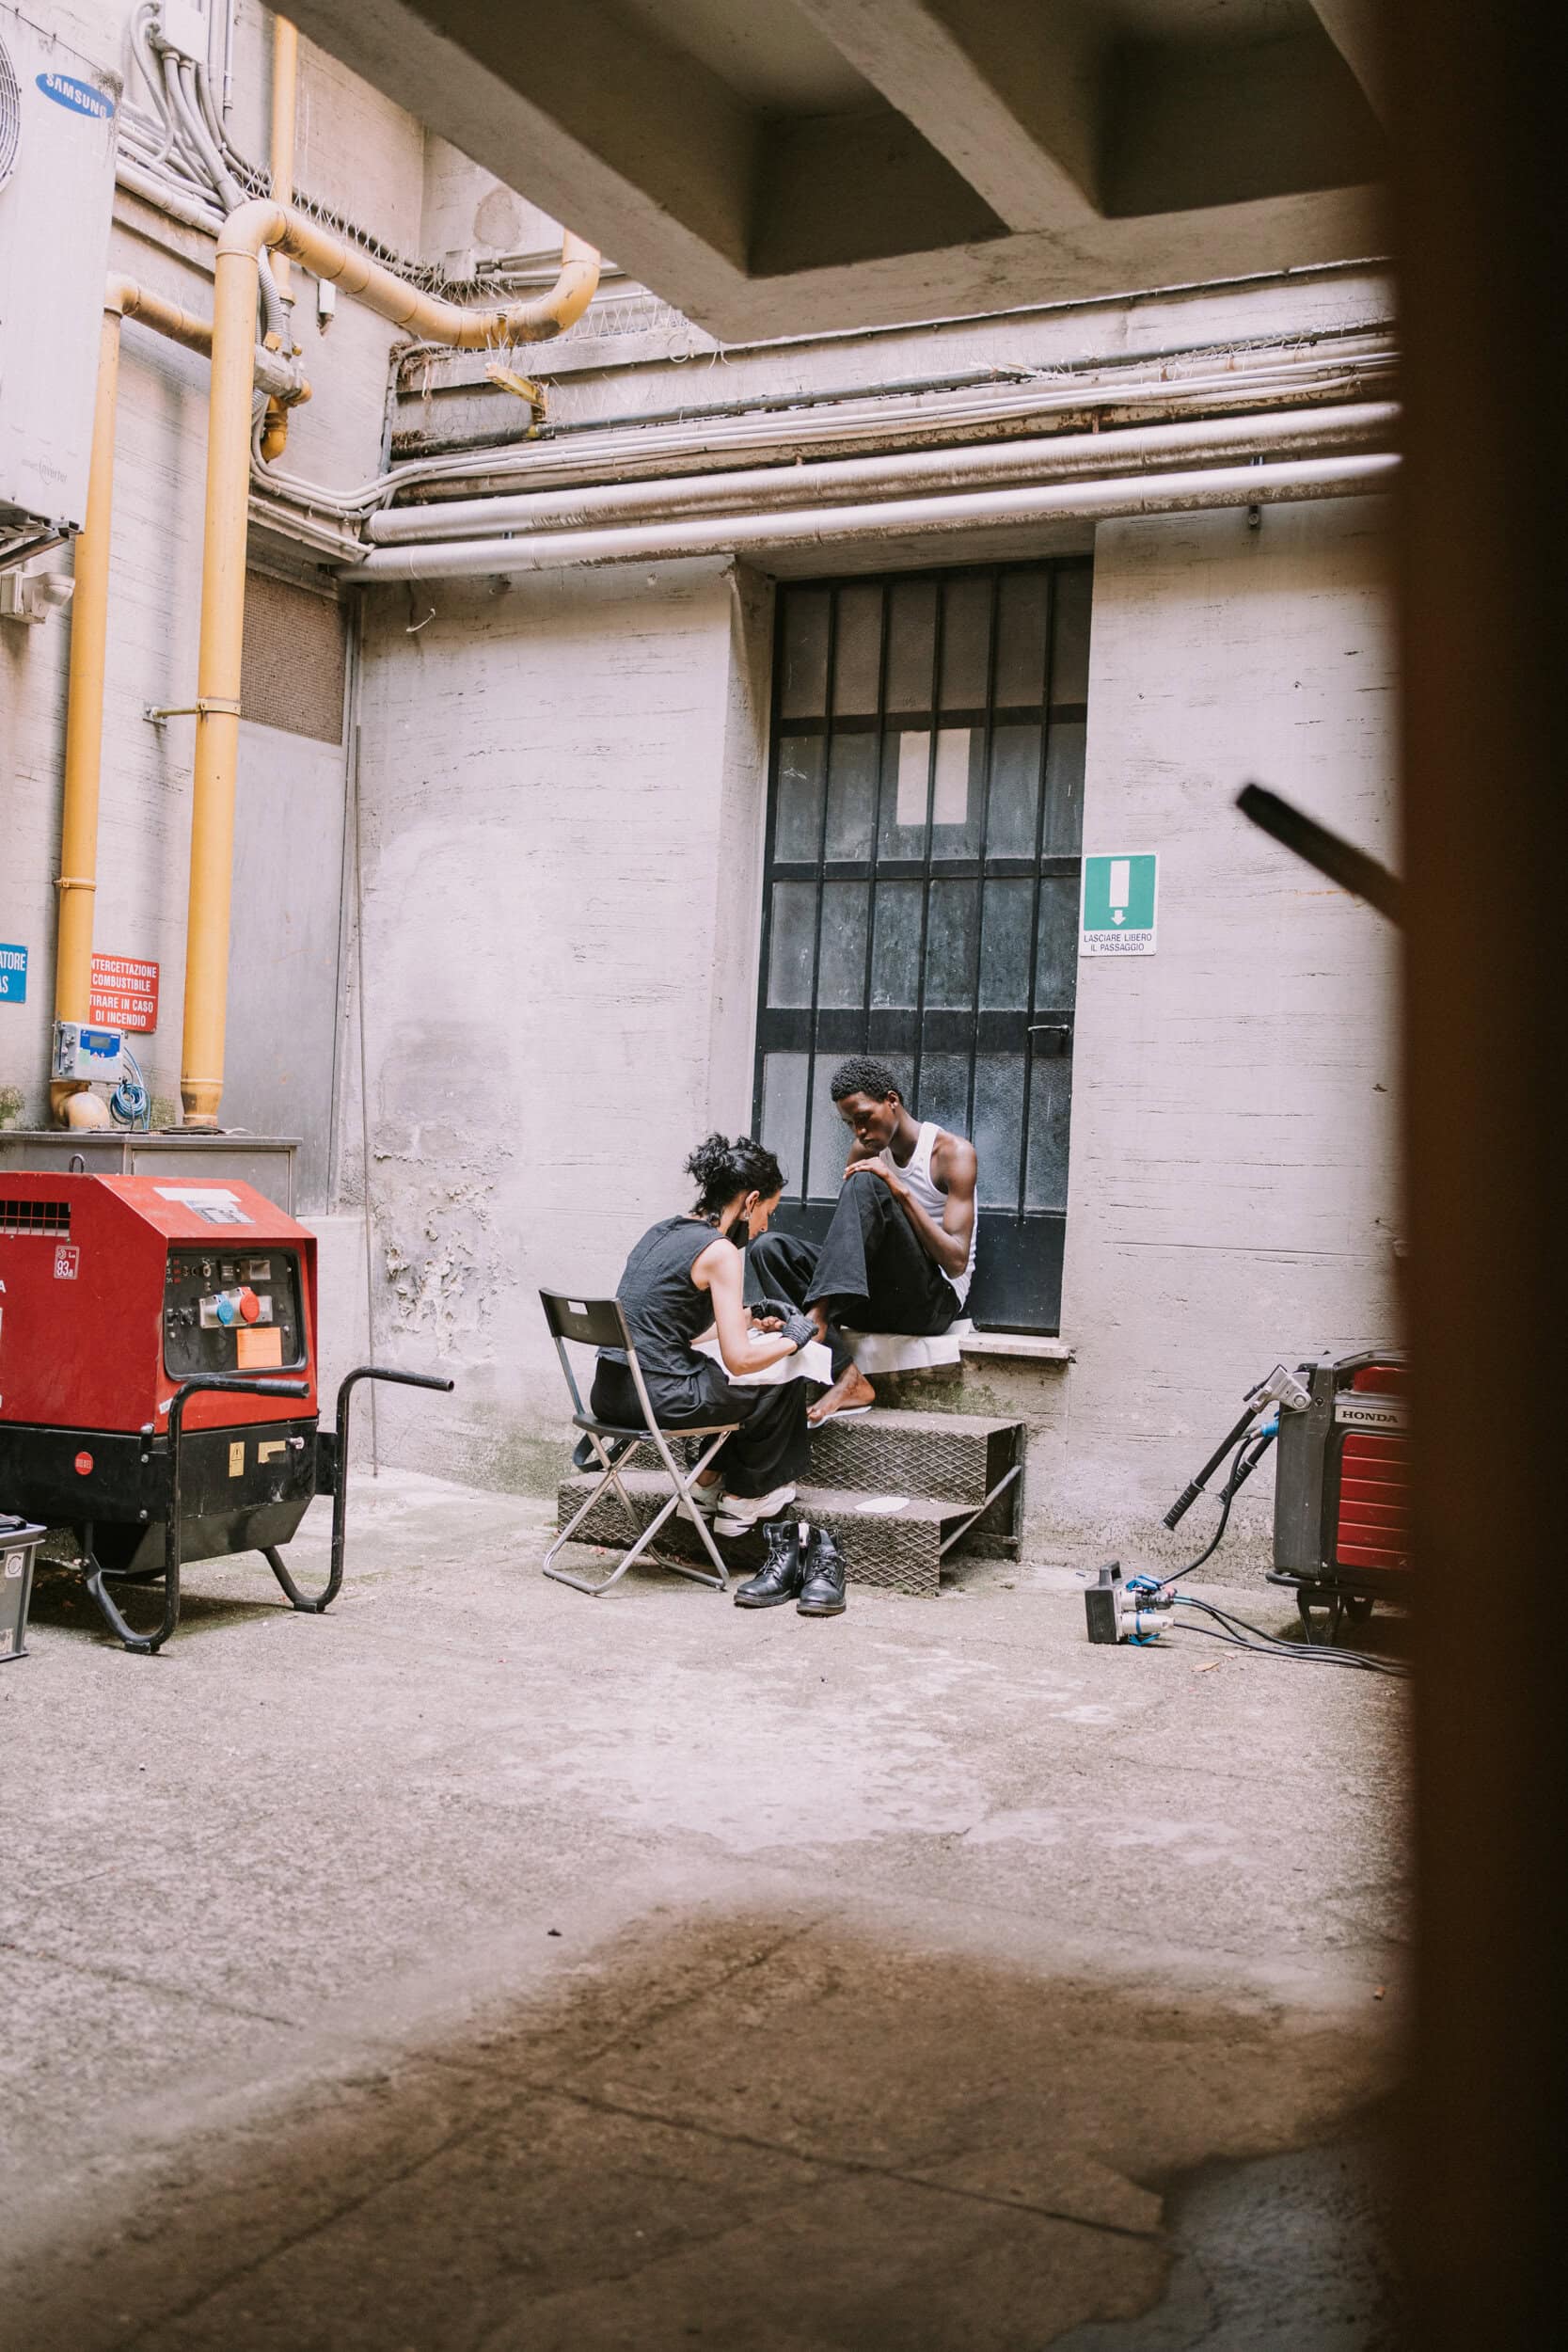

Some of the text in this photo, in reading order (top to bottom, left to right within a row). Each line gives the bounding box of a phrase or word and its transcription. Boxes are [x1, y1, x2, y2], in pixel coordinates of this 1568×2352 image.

[46, 73, 106, 119] SAMSUNG
[1084, 933, 1152, 942] LASCIARE LIBERO
[1100, 943, 1145, 951] PASSAGGIO
[92, 973, 150, 993] COMBUSTIBILE
[121, 998, 130, 1009] IN
[133, 999, 153, 1013] CASO
[95, 1009, 147, 1026] DI INCENDIO
[1342, 1411, 1399, 1423] HONDA
